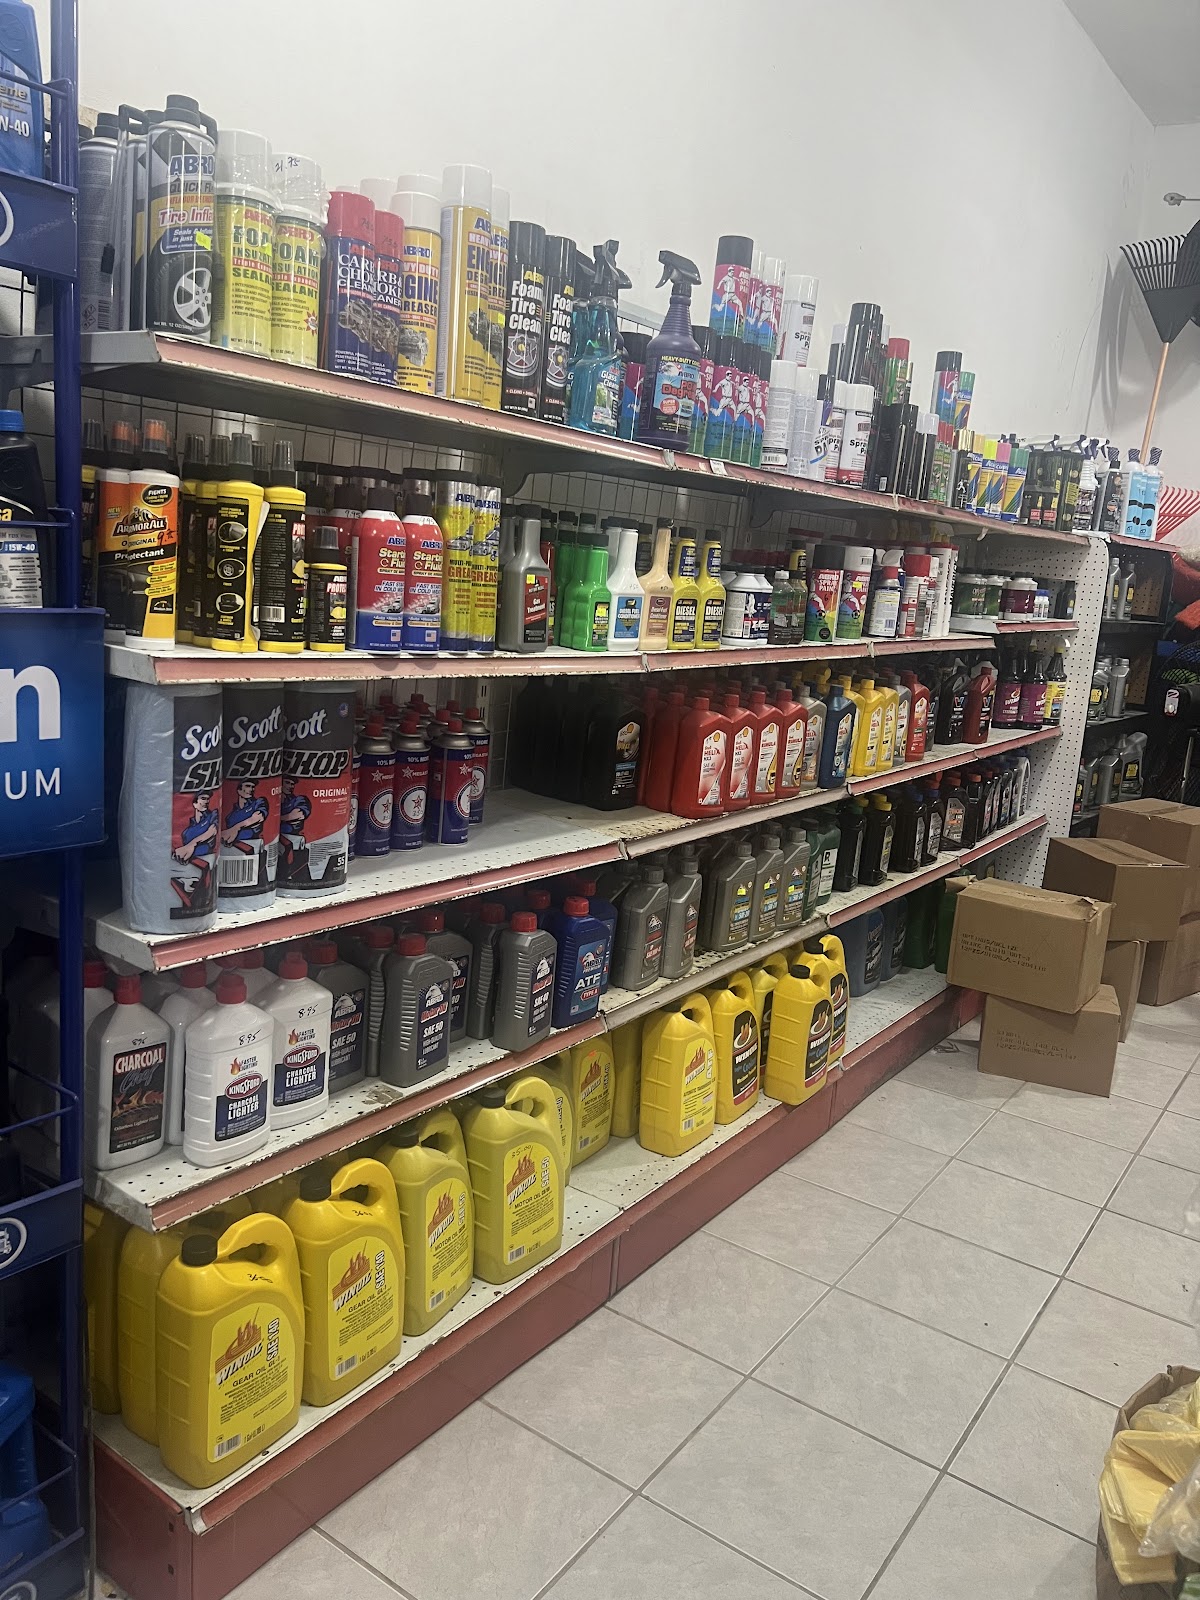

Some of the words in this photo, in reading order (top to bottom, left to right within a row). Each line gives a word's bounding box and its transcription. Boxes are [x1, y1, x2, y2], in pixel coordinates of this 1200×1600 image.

[168, 155, 215, 176] ABRO
[160, 208, 187, 226] Tire
[275, 242, 320, 268] OAM
[511, 280, 544, 302] Foam
[510, 297, 537, 316] Tire
[508, 313, 541, 335] Clean
[552, 309, 571, 329] Tire
[549, 326, 571, 345] Clea
[661, 355, 693, 366] HEAVY-DUTY
[601, 370, 617, 382] Glass
[107, 506, 121, 514] NEW
[8, 543, 36, 551] 15W-40
[676, 605, 695, 616] DIESEL
[706, 605, 723, 616] DIESEL
[0, 665, 61, 744] n
[228, 705, 283, 749] Scott
[286, 708, 328, 742] cott
[5, 767, 61, 800] UM
[312, 787, 348, 798] ORIGINAL
[337, 857, 345, 865] 55
[575, 972, 602, 990] ATF
[426, 994, 444, 1008] ABRO
[583, 989, 594, 999] TYPE
[299, 1028, 314, 1037] FASTER
[423, 1024, 435, 1038] SAE
[435, 1020, 444, 1032] 50
[331, 1035, 345, 1050] SAE
[346, 1032, 357, 1043] 50
[115, 1048, 163, 1074] CHARCOAL
[242, 1056, 257, 1065] FASTER
[286, 1049, 318, 1065] KINGSFORD
[285, 1070, 317, 1088] LIGHTER
[286, 1064, 317, 1079] CHARCOAL
[229, 1076, 260, 1095] KINGSFORD
[228, 1094, 259, 1111] CHARCOAL
[228, 1101, 259, 1120] LIGHTER
[514, 1195, 533, 1209] MOTOR
[533, 1190, 542, 1200] OIL
[434, 1236, 452, 1251] MOTOR
[452, 1229, 460, 1240] OIL
[348, 1299, 366, 1313] GEAR
[366, 1293, 376, 1303] OIL
[268, 1318, 280, 1338] 140
[267, 1338, 279, 1362] SAE
[232, 1372, 254, 1387] GEAR
[255, 1365, 268, 1375] OIL
